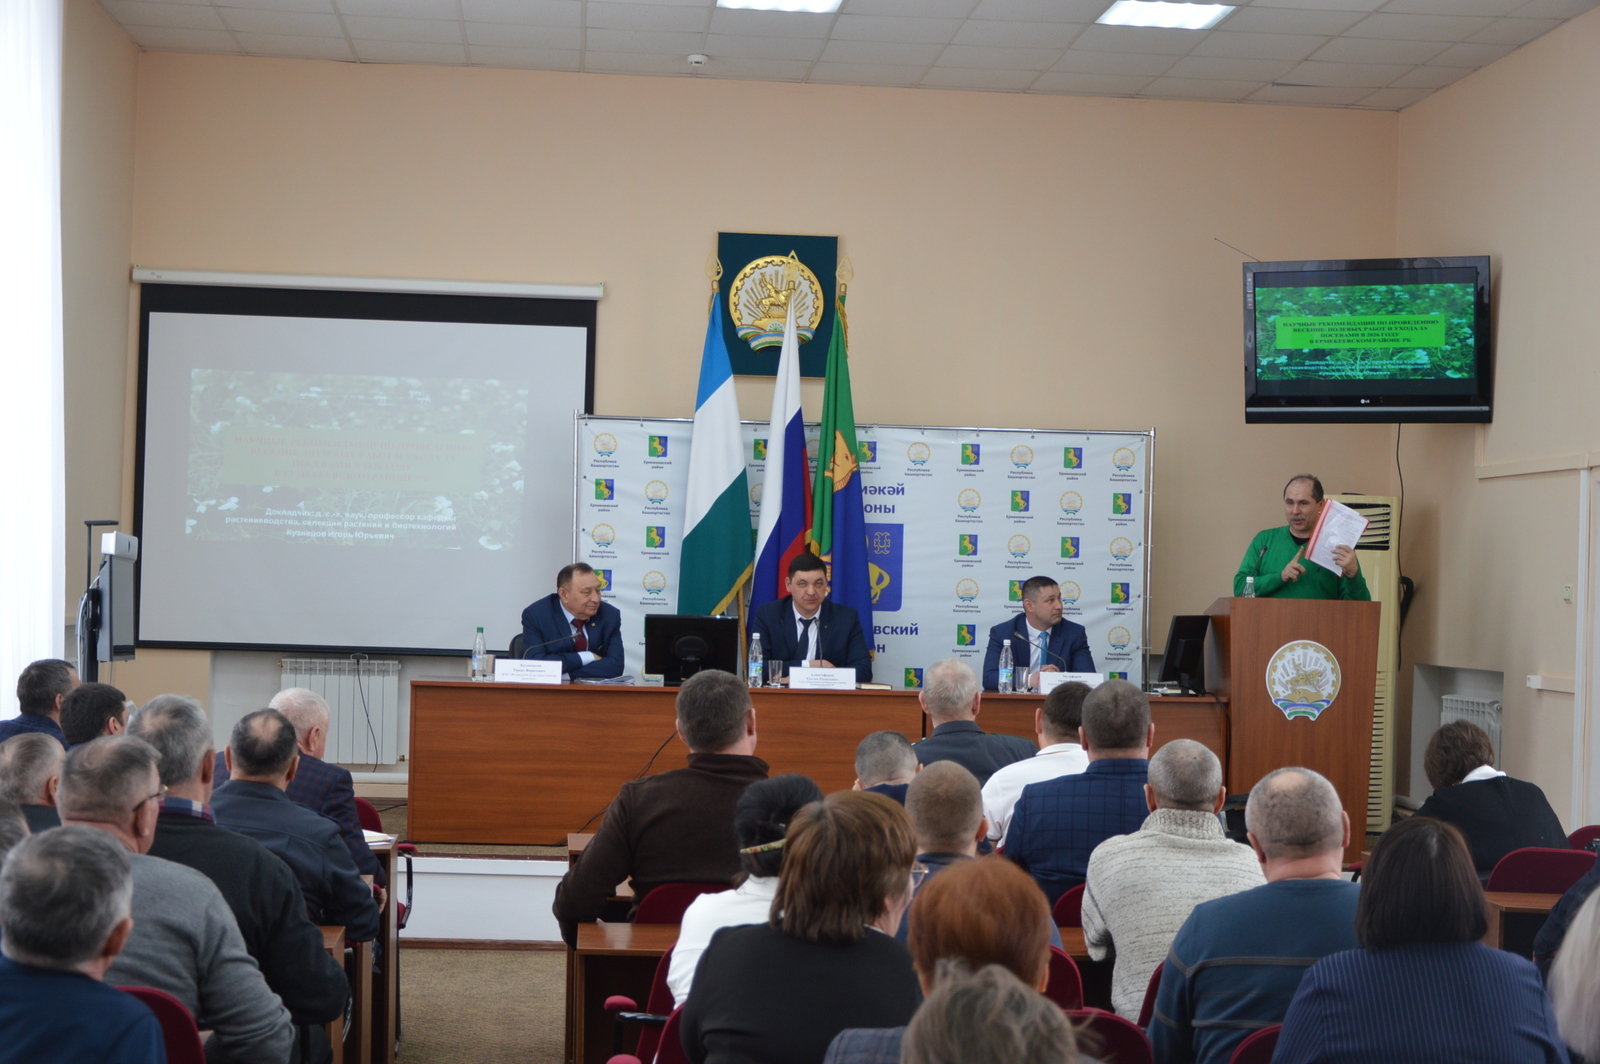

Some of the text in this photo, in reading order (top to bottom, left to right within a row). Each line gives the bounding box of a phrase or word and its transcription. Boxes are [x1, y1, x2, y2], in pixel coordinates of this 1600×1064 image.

[864, 503, 895, 514] оны
[368, 512, 416, 521] профессор
[225, 516, 300, 526] растениеводства,
[344, 520, 382, 529] растений
[286, 529, 395, 540] Кузнецов Игорь Юрьевич
